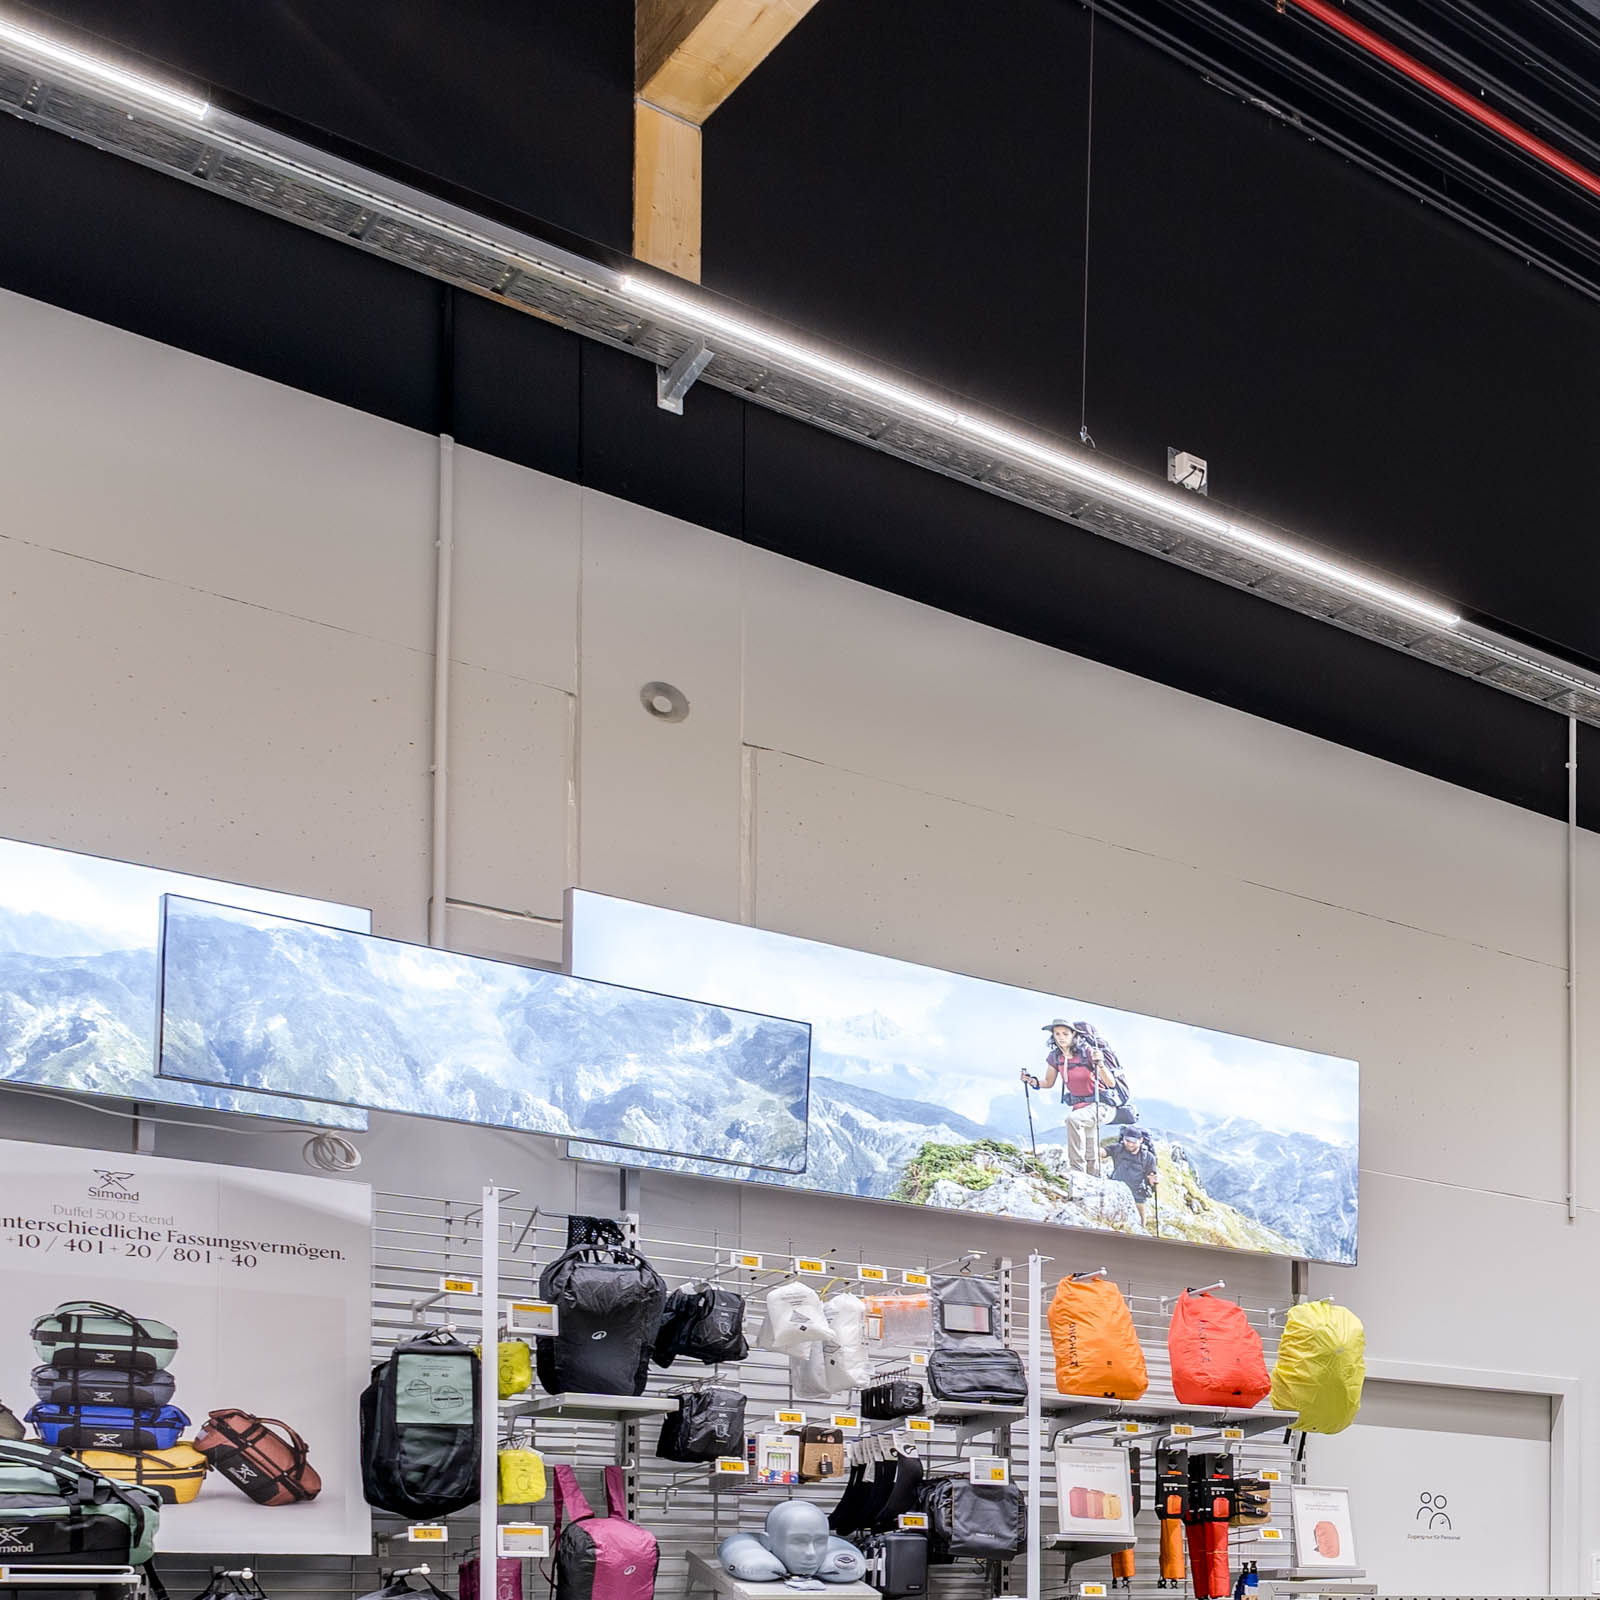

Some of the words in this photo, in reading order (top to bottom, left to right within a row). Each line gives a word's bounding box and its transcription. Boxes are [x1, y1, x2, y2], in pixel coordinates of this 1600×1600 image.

[88, 1187, 140, 1201] Simond
[53, 1204, 94, 1219] Duffel
[95, 1207, 125, 1221] 500
[128, 1211, 174, 1226] Extend
[0, 1216, 161, 1244] nterschiedliche
[167, 1229, 346, 1261] Fassungsvermögen.
[64, 1238, 93, 1254] 40
[124, 1243, 152, 1259] 20
[173, 1248, 200, 1263] 80
[231, 1253, 257, 1268] 40
[0, 1543, 34, 1553] mond
